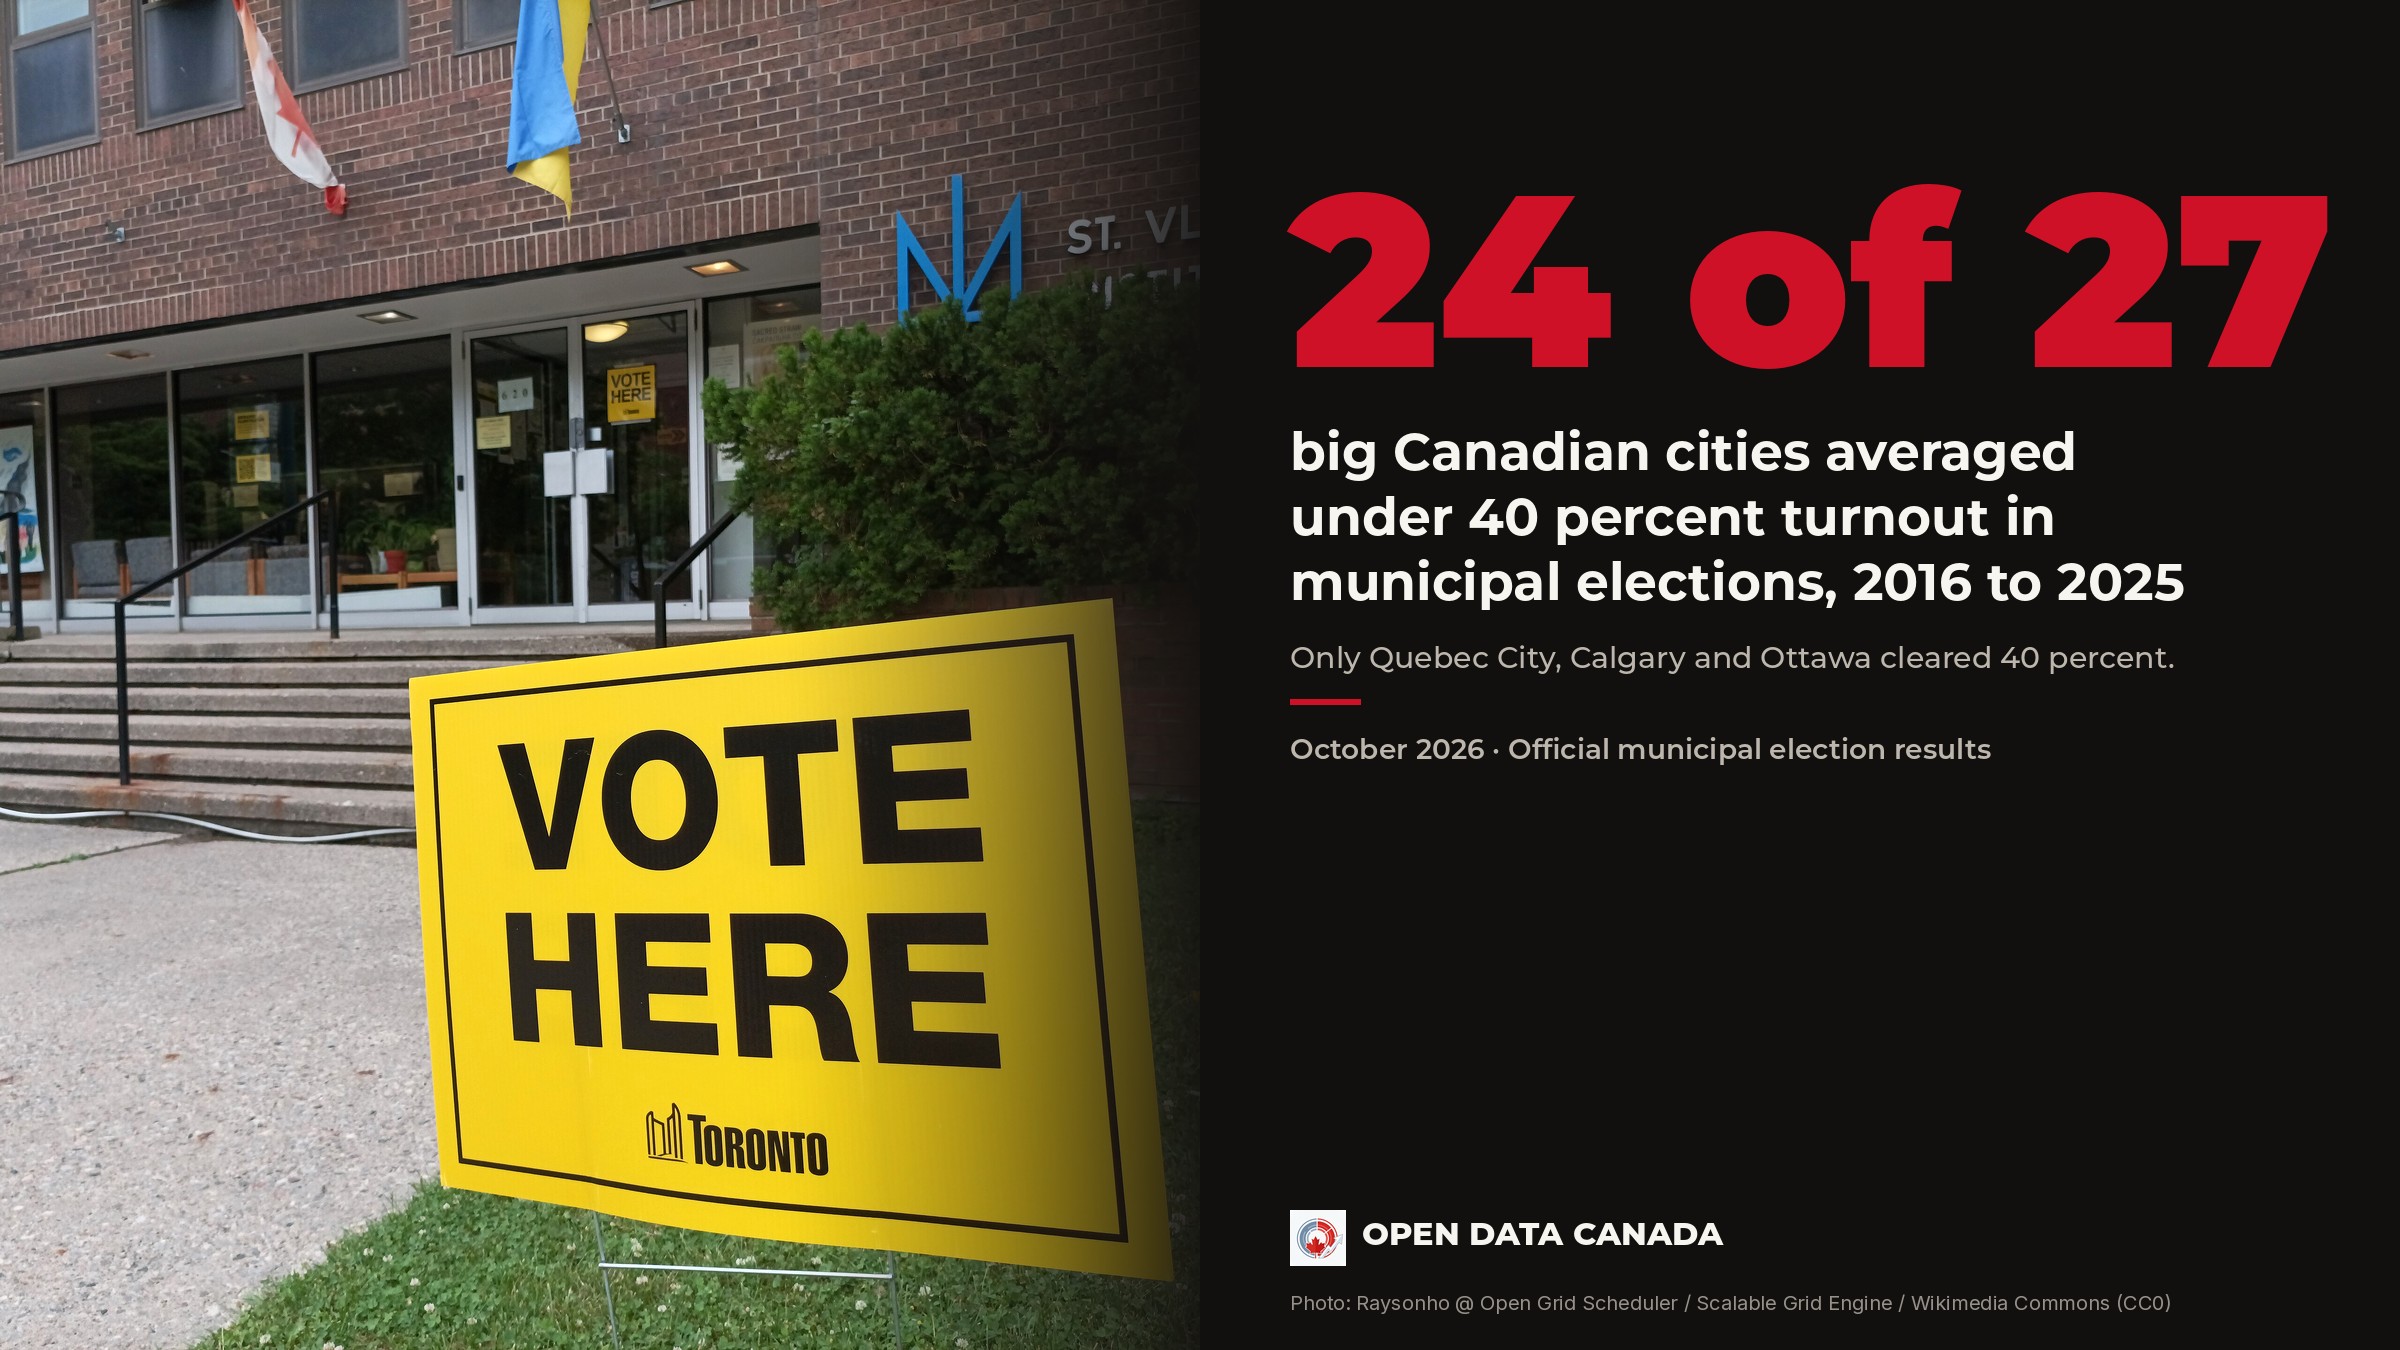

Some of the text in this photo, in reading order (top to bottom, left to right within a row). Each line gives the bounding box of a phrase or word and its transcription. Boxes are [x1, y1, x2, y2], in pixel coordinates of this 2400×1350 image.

[1066, 215, 1121, 254] ST.
[611, 371, 651, 388] VOTE
[612, 387, 652, 404] HERE
[498, 709, 983, 871] VOTE
[505, 912, 1001, 1069] HERE
[687, 1114, 829, 1176] TORONTO
